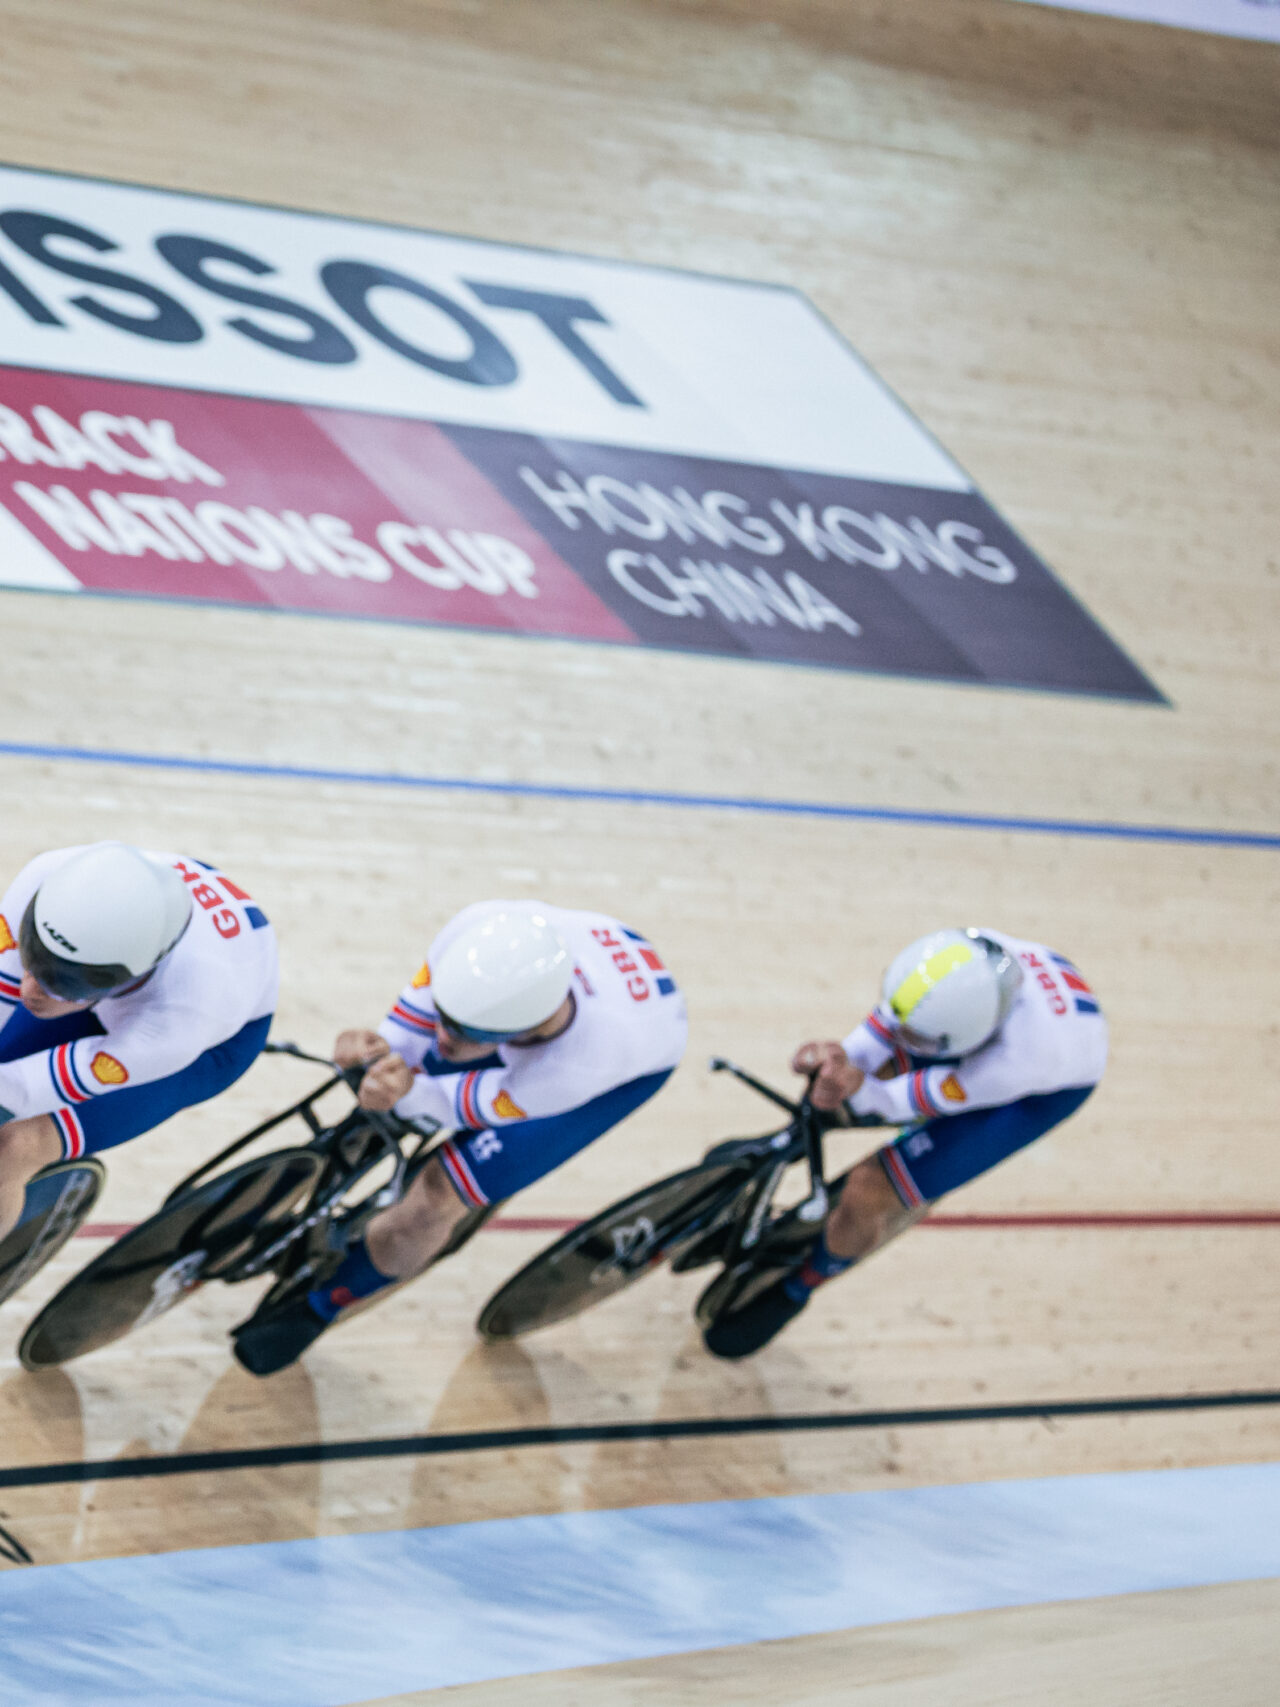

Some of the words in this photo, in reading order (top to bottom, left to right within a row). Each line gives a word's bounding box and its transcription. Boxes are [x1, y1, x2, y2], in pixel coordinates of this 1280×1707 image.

[13, 481, 394, 584] NATIONS
[376, 521, 540, 600] CUP
[519, 464, 786, 557] HONG
[771, 498, 1017, 584] KONG
[606, 548, 862, 637] CHINA
[590, 929, 650, 1002] GBR
